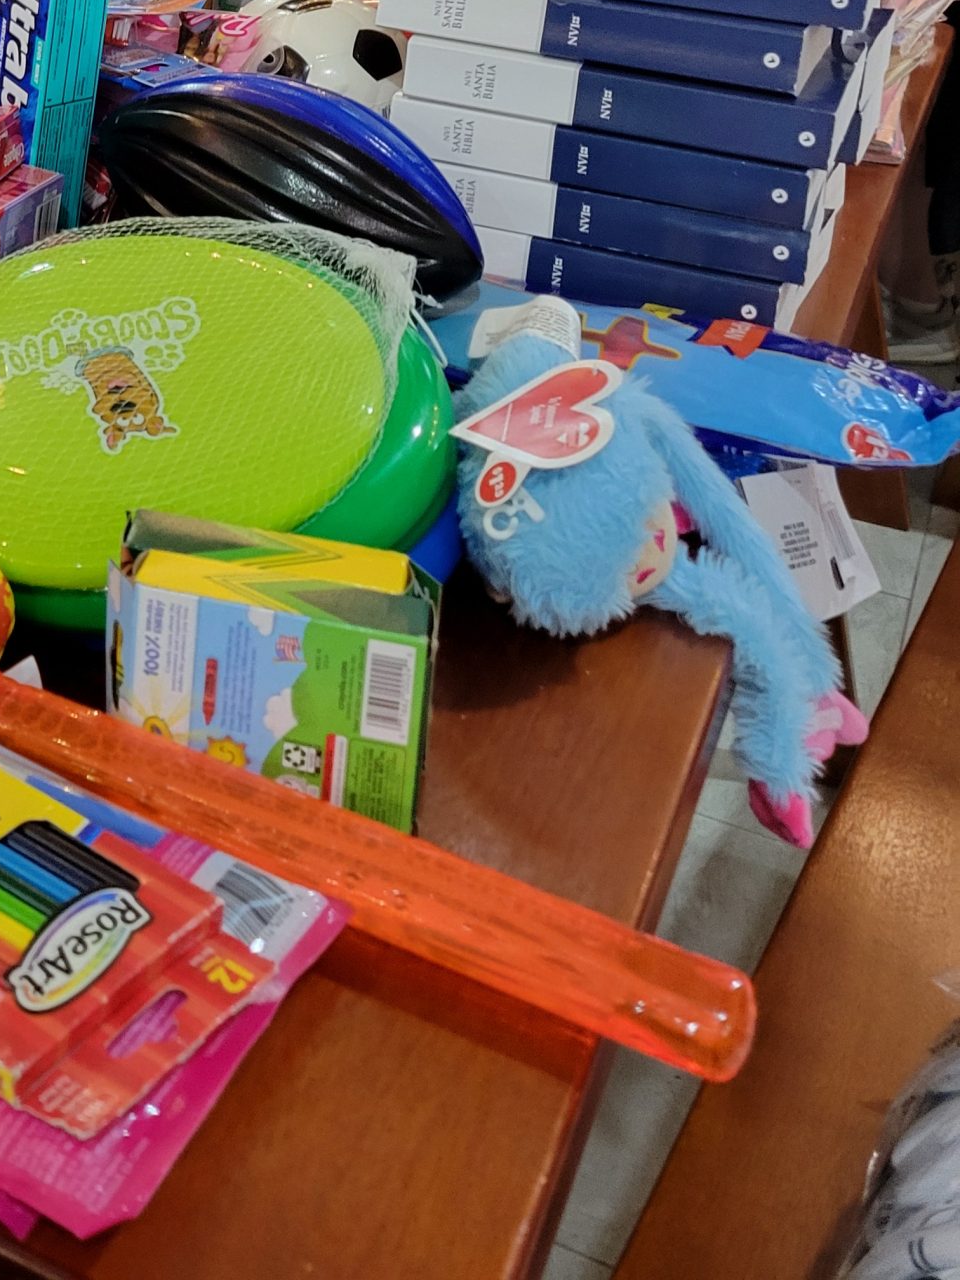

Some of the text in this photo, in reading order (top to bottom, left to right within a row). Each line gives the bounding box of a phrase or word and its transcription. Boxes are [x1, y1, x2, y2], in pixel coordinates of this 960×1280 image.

[568, 22, 580, 46] NVI
[472, 63, 485, 99] SANTA
[483, 65, 496, 100] BIBLIA
[600, 95, 612, 120] NVI
[451, 119, 463, 153] SANTA
[462, 120, 475, 154] BIBLIA
[577, 152, 588, 175] NVI
[455, 178, 465, 201] NTA
[579, 210, 590, 233] NVI
[552, 263, 563, 287] NVI
[143, 634, 161, 677] 100%
[24, 892, 143, 998] RoseArt
[206, 954, 255, 995] 12
